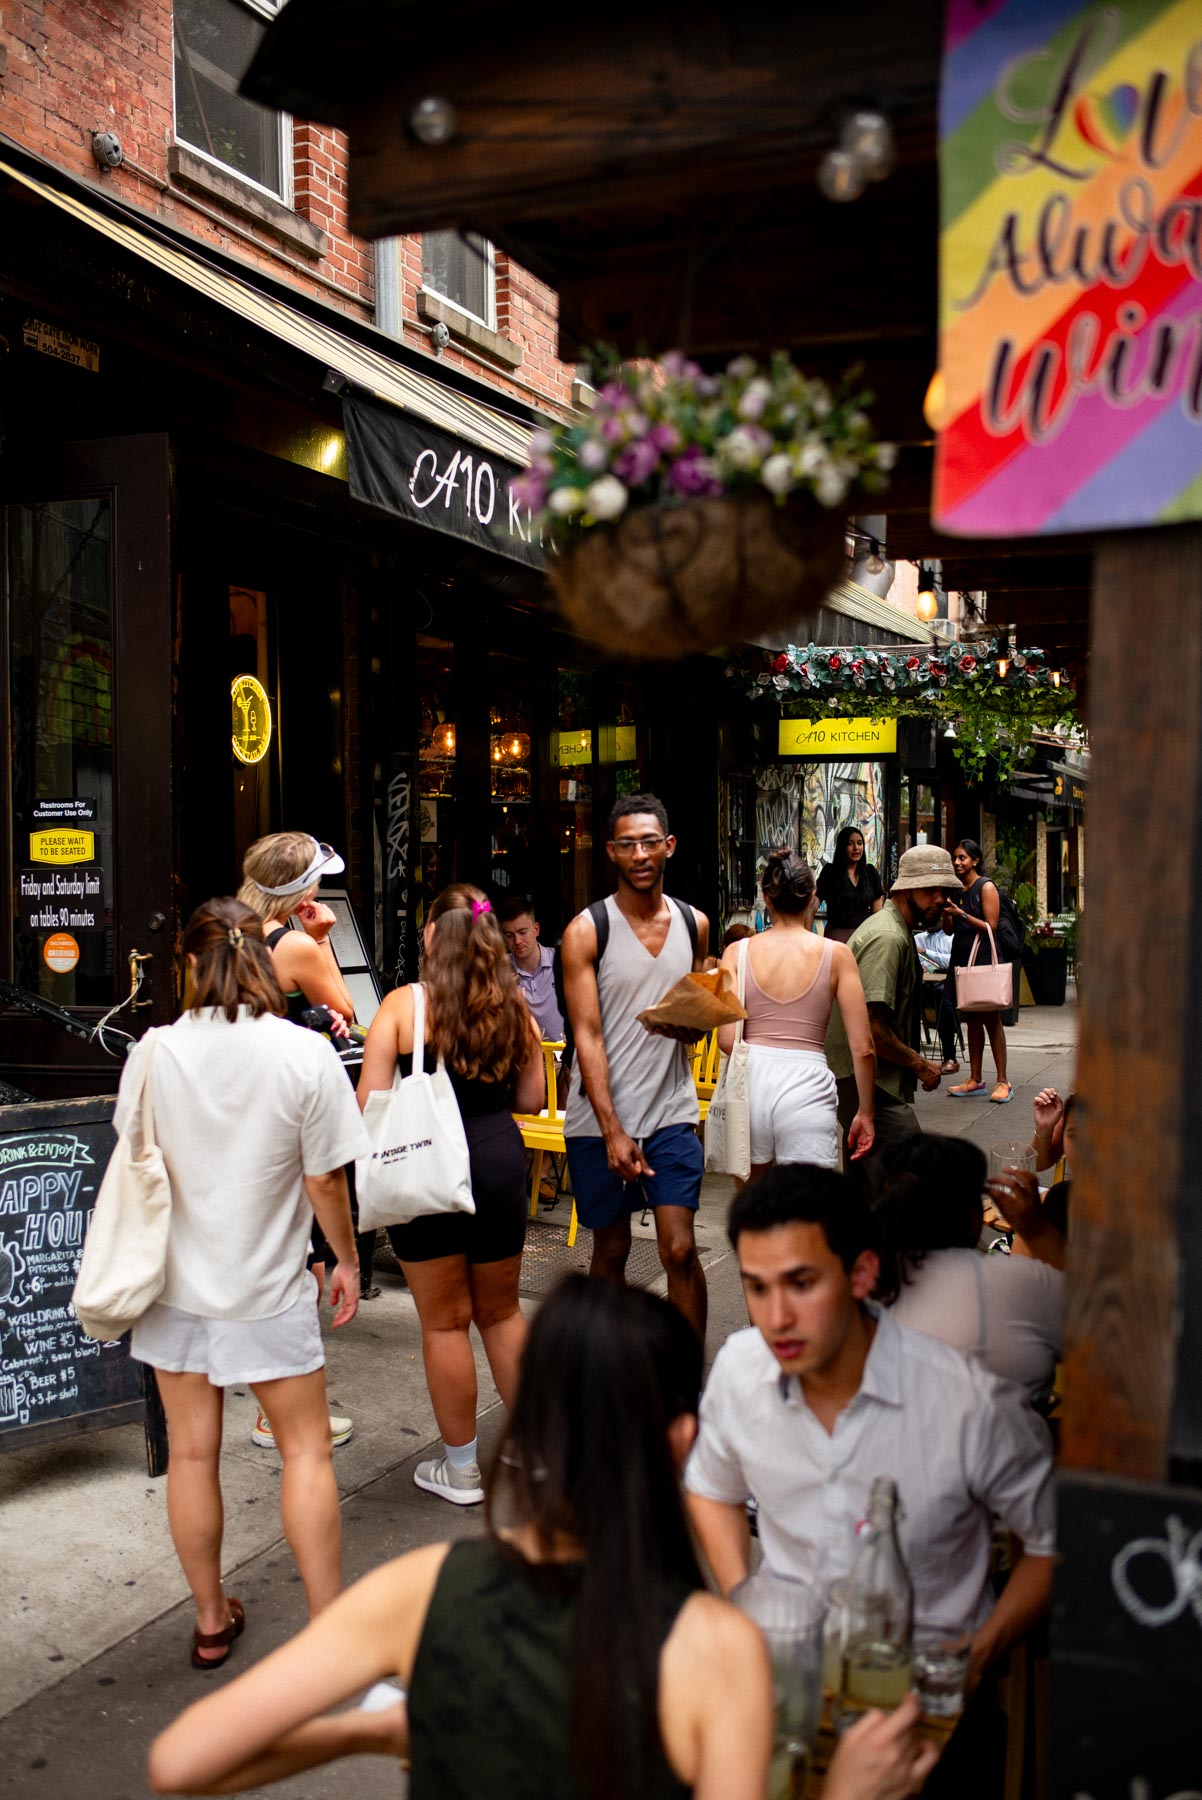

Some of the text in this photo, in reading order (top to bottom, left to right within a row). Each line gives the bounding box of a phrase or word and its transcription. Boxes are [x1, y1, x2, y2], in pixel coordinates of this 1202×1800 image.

[43, 325, 60, 340] GATE
[42, 343, 80, 364] 504-2837
[830, 731, 880, 742] KITCHEN
[78, 809, 93, 817] Only
[40, 837, 84, 846] PLEASE WAIT
[61, 847, 86, 855] SEATED
[21, 872, 100, 900] Friday and Saturday limit
[30, 905, 94, 927] on tables 90 minutes
[26, 1249, 84, 1266] MARGARITA &
[28, 1262, 69, 1275] PITCHERS
[24, 1330, 75, 1355] WINE $5
[29, 1366, 75, 1390] BEER $5
